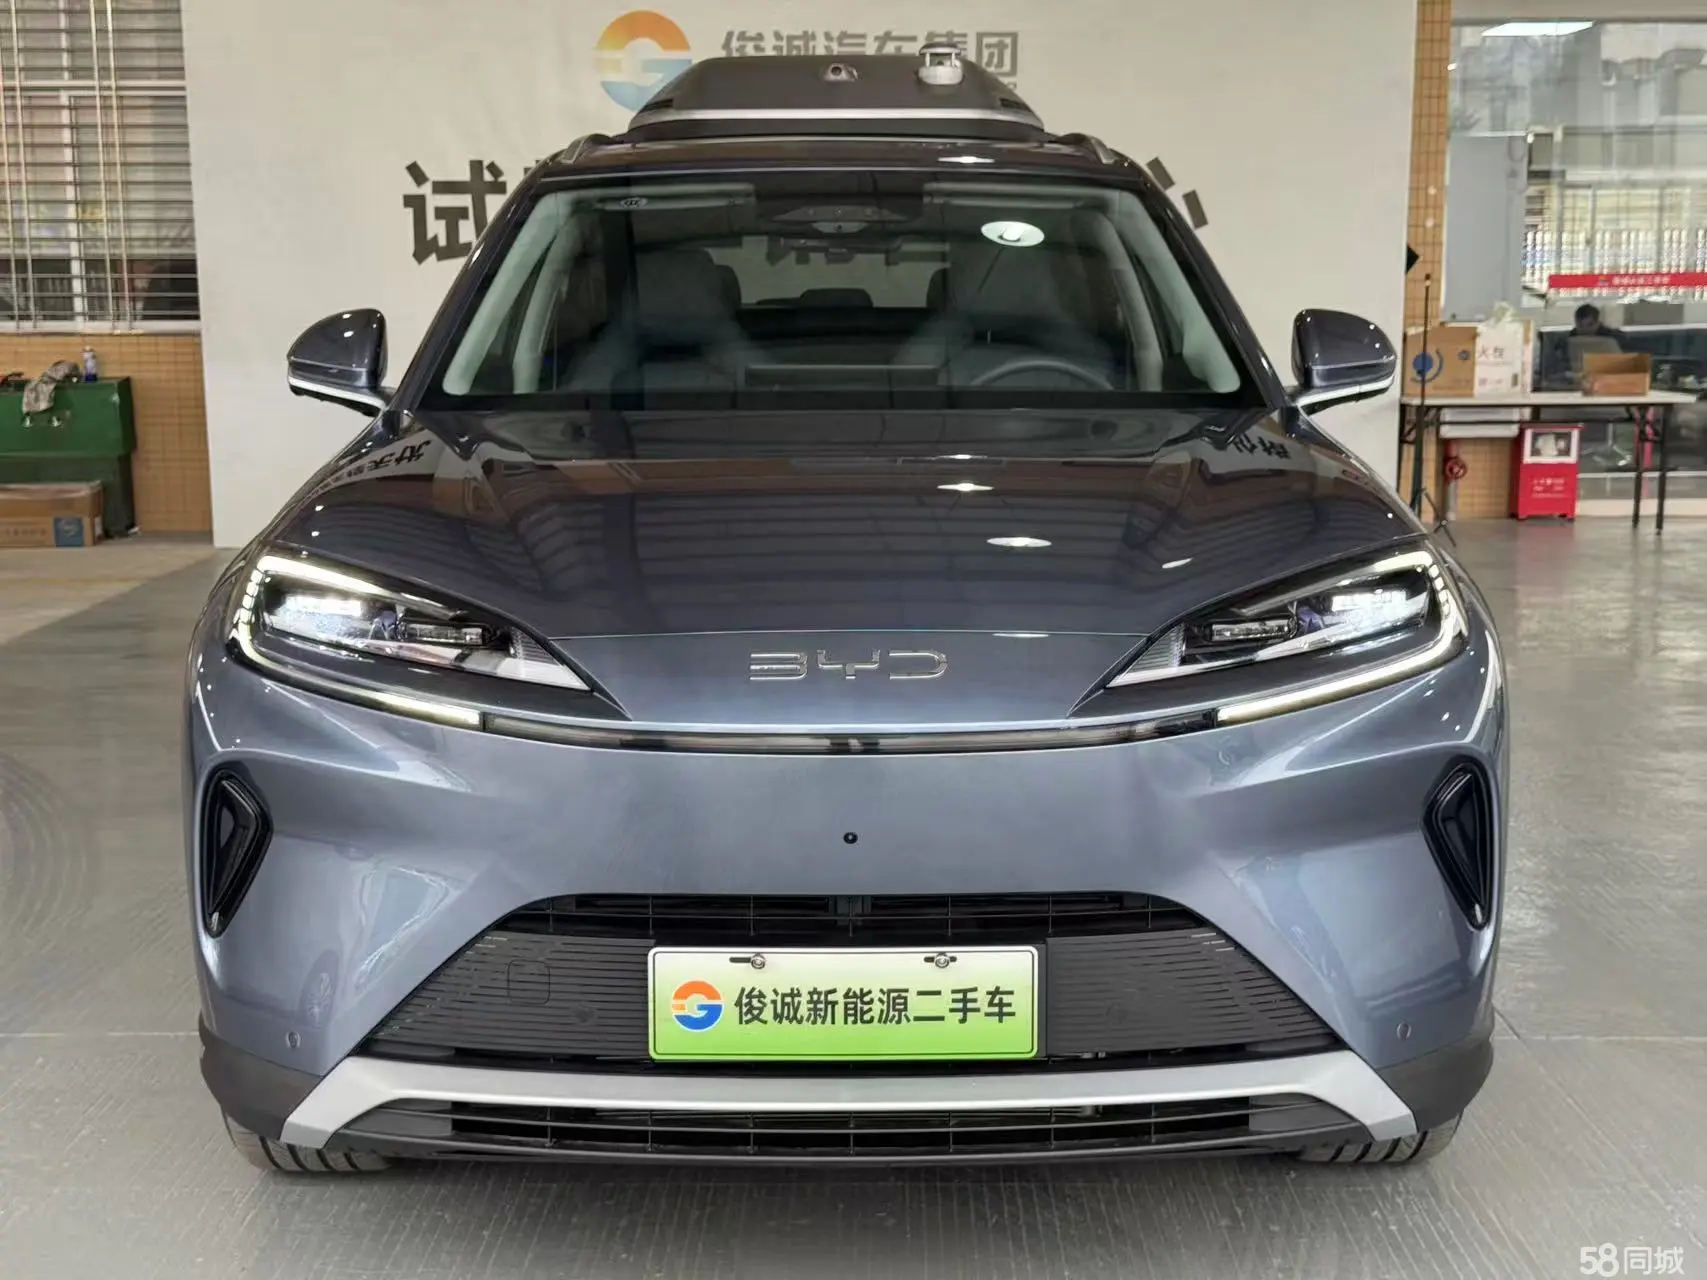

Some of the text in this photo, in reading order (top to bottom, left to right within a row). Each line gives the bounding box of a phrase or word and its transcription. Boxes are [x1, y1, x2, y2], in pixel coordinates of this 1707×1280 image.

[749, 649, 949, 682] BYD
[734, 986, 1017, 1026] 俊诚新能源二手车
